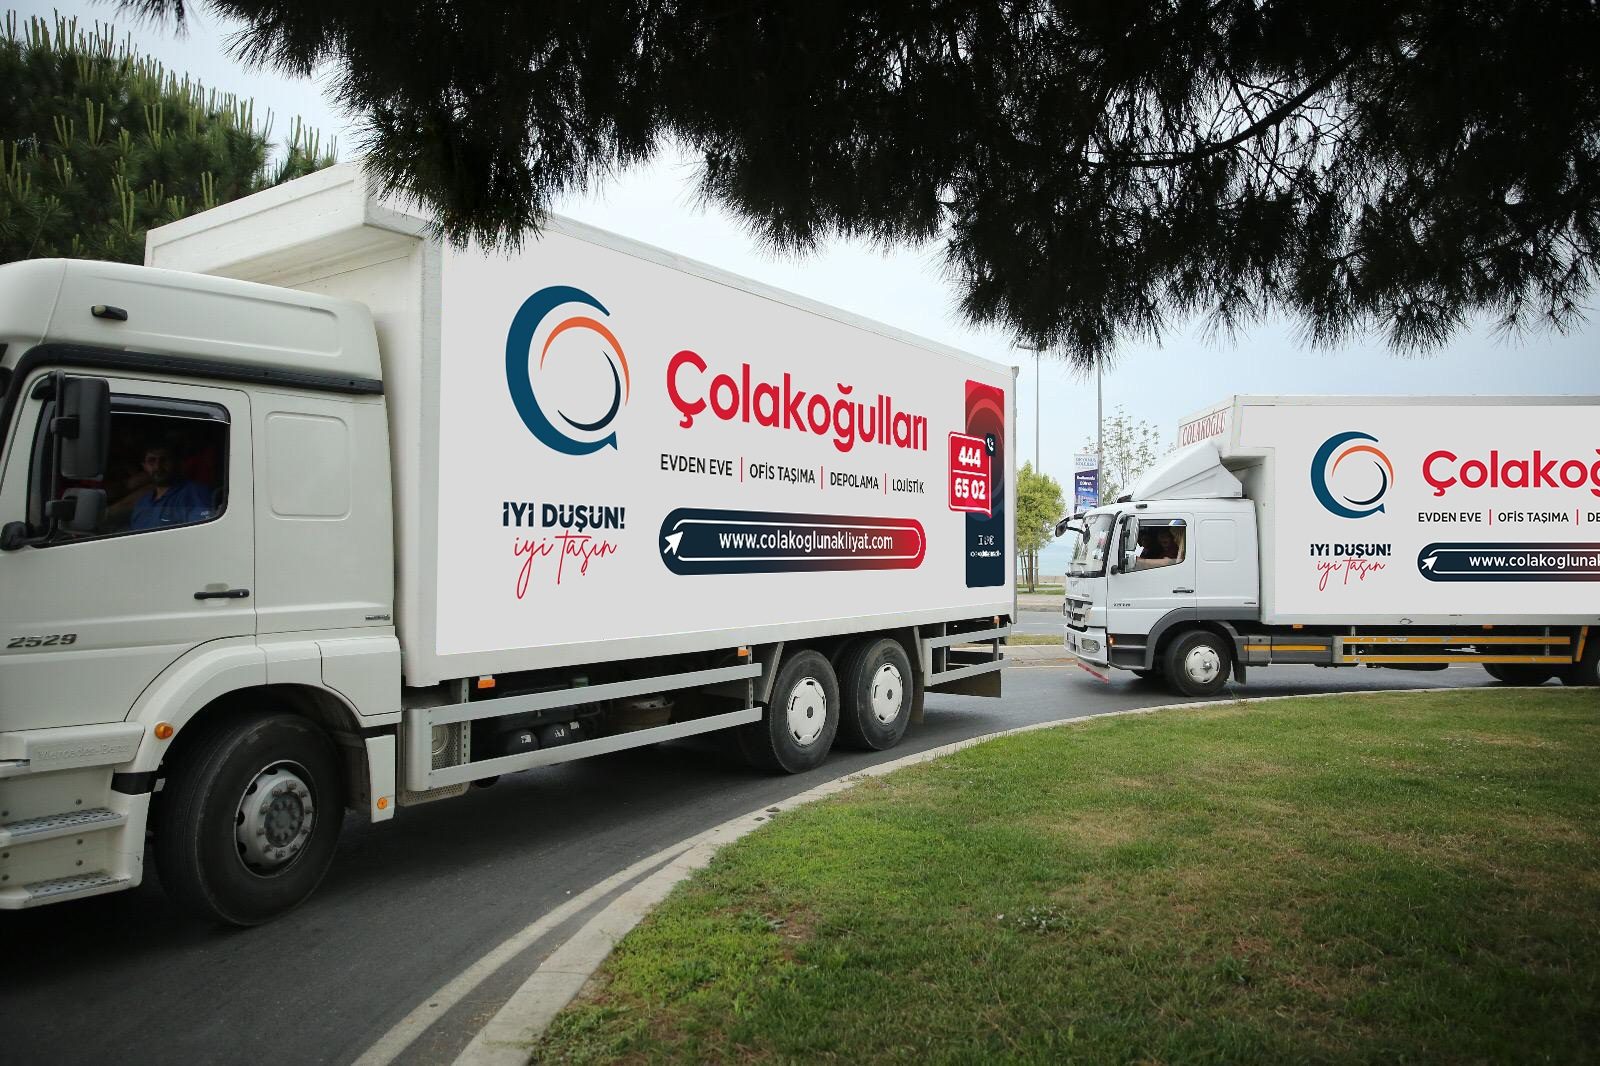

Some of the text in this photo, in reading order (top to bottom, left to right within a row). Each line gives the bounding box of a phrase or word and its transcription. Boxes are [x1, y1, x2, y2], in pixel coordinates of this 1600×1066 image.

[666, 350, 928, 453] Çolakoğulları
[660, 453, 733, 477] EVDEN EVE
[958, 446, 981, 468] 444
[749, 461, 816, 485] OFİS TAŞIMA
[830, 471, 879, 490] DEPOLAMA
[892, 478, 925, 494] LOJİSTİK
[954, 477, 986, 500] 65 02
[1418, 512, 1482, 523] EVDEN EVE
[1498, 510, 1569, 525] OFİS TAŞIMA
[719, 530, 893, 553] www.colakoglunakliyat.com
[514, 537, 554, 600] iyi
[6, 633, 77, 649] 2529
